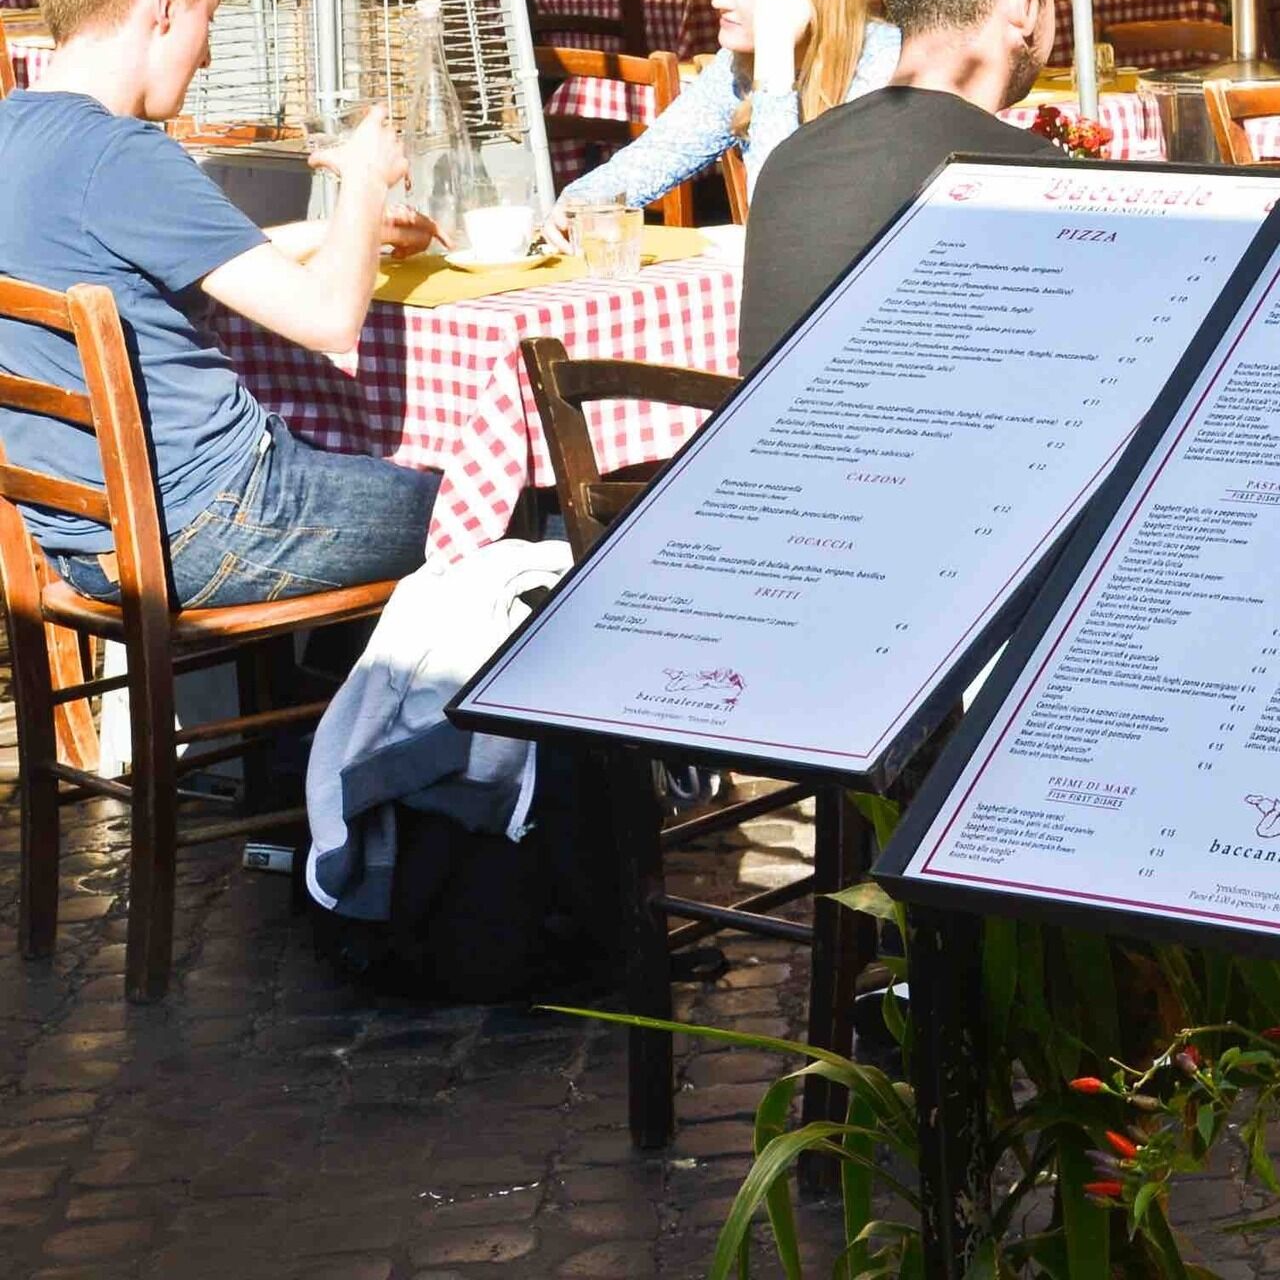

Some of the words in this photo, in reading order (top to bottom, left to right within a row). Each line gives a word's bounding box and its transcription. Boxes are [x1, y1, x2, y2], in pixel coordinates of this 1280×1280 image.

[1043, 177, 1213, 207] Baccanale
[1056, 228, 1117, 242] PIZZA
[846, 472, 906, 485] CALZONI
[1231, 490, 1255, 500] FIRST
[786, 535, 853, 550] FOCACCIA
[753, 586, 801, 600] FRITTI
[635, 691, 735, 712] baccanaleroma.it
[1047, 776, 1083, 789] PRIMI
[1085, 780, 1101, 791] DI
[1102, 783, 1137, 796] MARE
[1047, 789, 1067, 799] FISH
[1067, 792, 1092, 803] FIRST
[1092, 796, 1123, 808] DISHES
